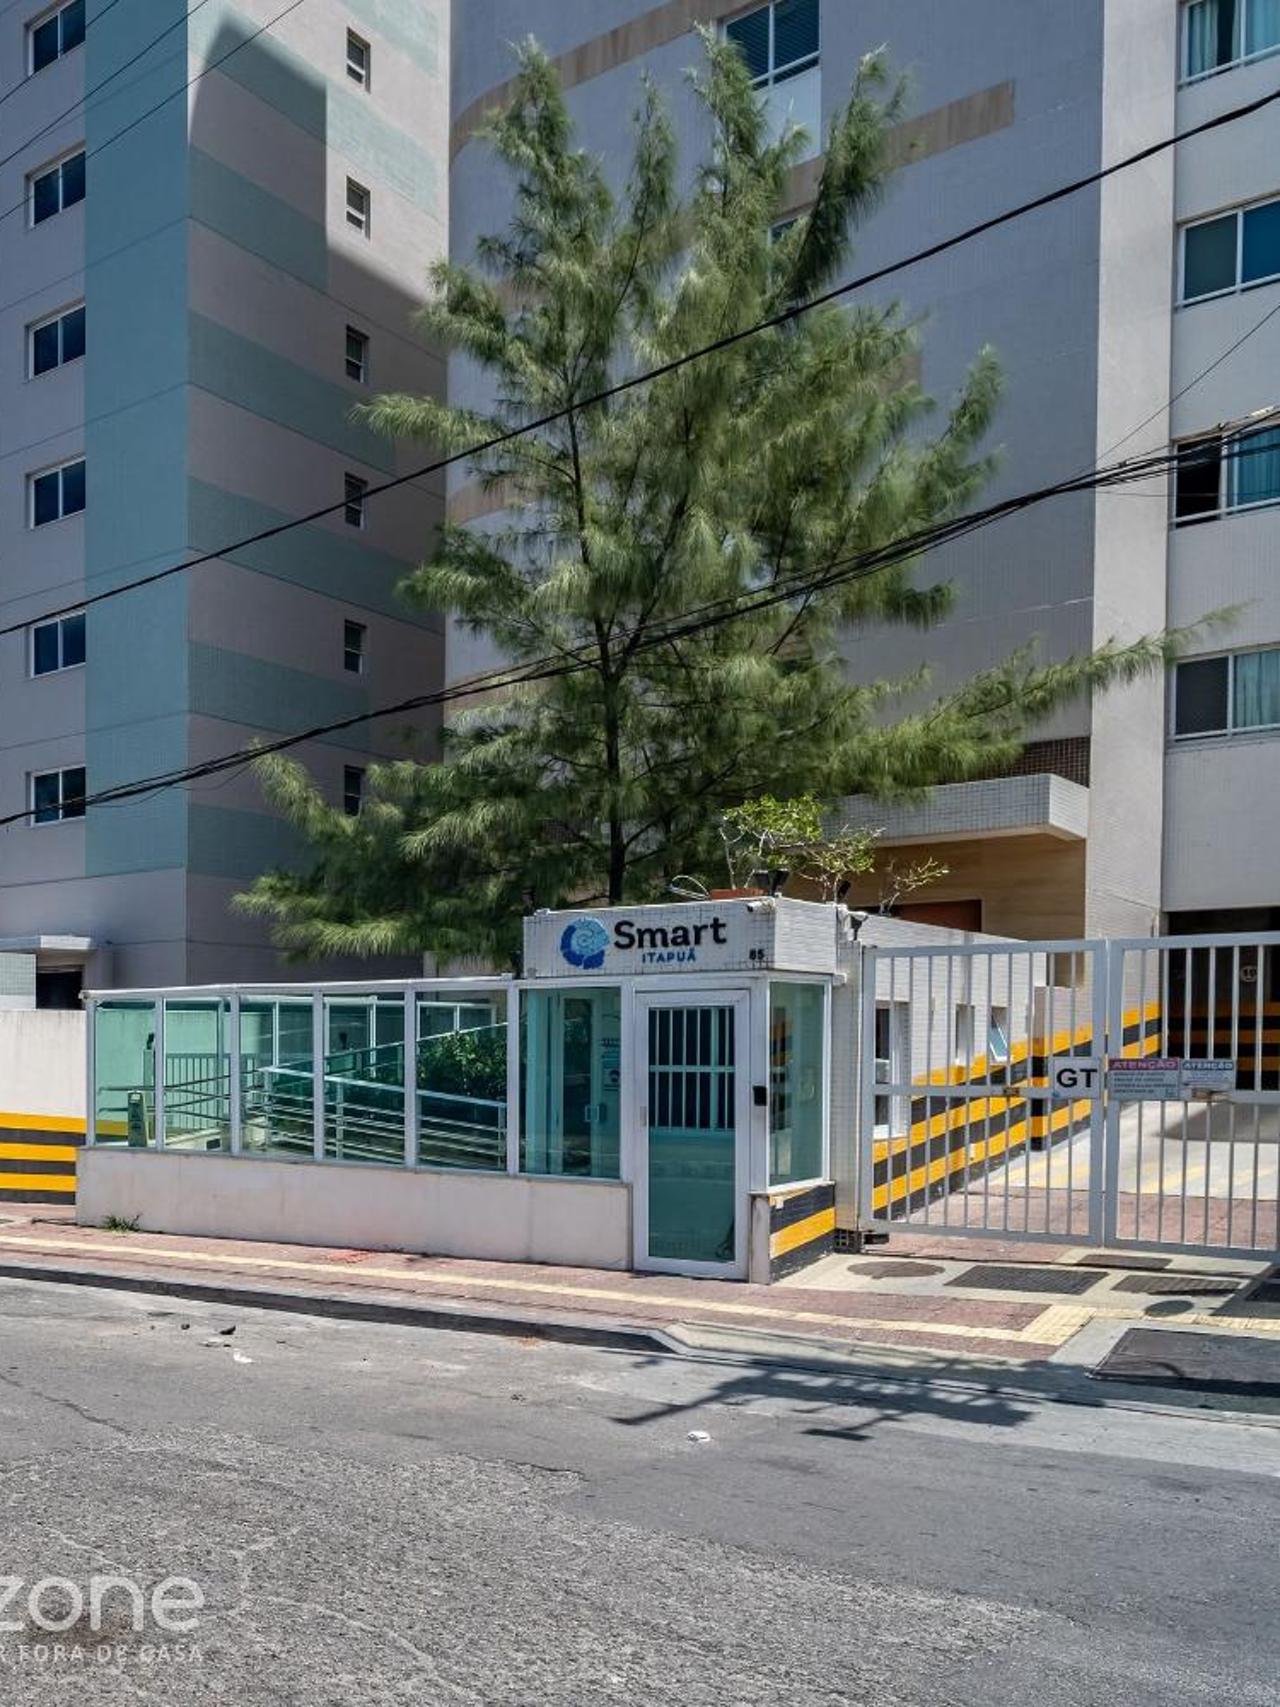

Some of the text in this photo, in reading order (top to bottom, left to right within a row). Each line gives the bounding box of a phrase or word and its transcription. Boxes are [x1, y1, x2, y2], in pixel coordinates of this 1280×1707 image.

[613, 917, 727, 949] Smart
[642, 948, 697, 964] ITAPUÃ
[1111, 1060, 1177, 1069] ATENÇÃO
[1056, 1068, 1098, 1088] GT
